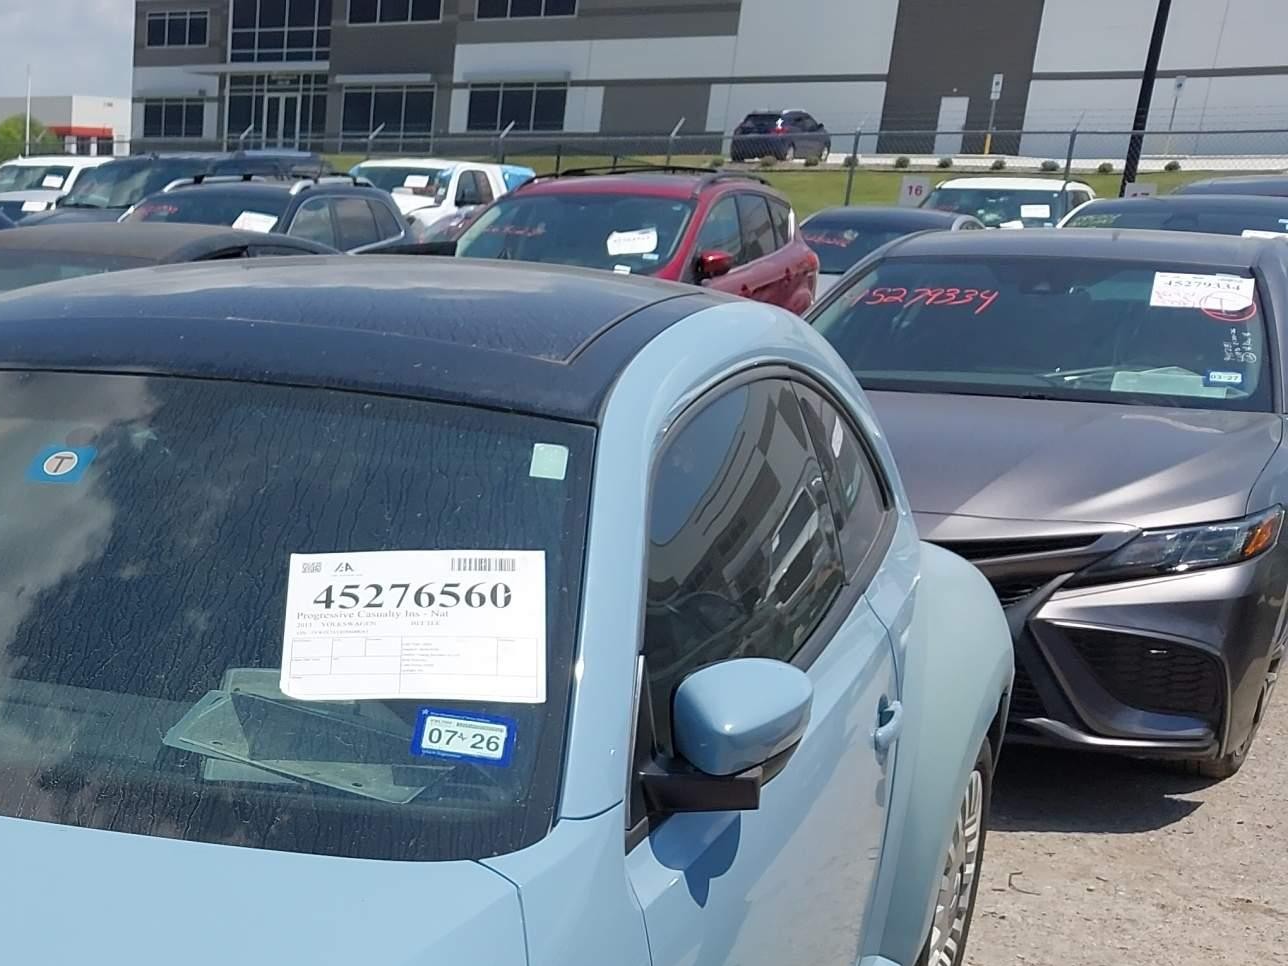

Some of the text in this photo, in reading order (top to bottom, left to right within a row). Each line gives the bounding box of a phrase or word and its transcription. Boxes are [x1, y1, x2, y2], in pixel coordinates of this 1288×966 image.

[908, 184, 923, 198] 16
[53, 455, 74, 473] T
[312, 582, 513, 610] 45276560
[296, 611, 356, 621] Progressive
[357, 609, 402, 620] Casualty
[405, 609, 421, 618] Ins
[430, 609, 450, 618] Nat
[428, 727, 500, 752] 07 26
